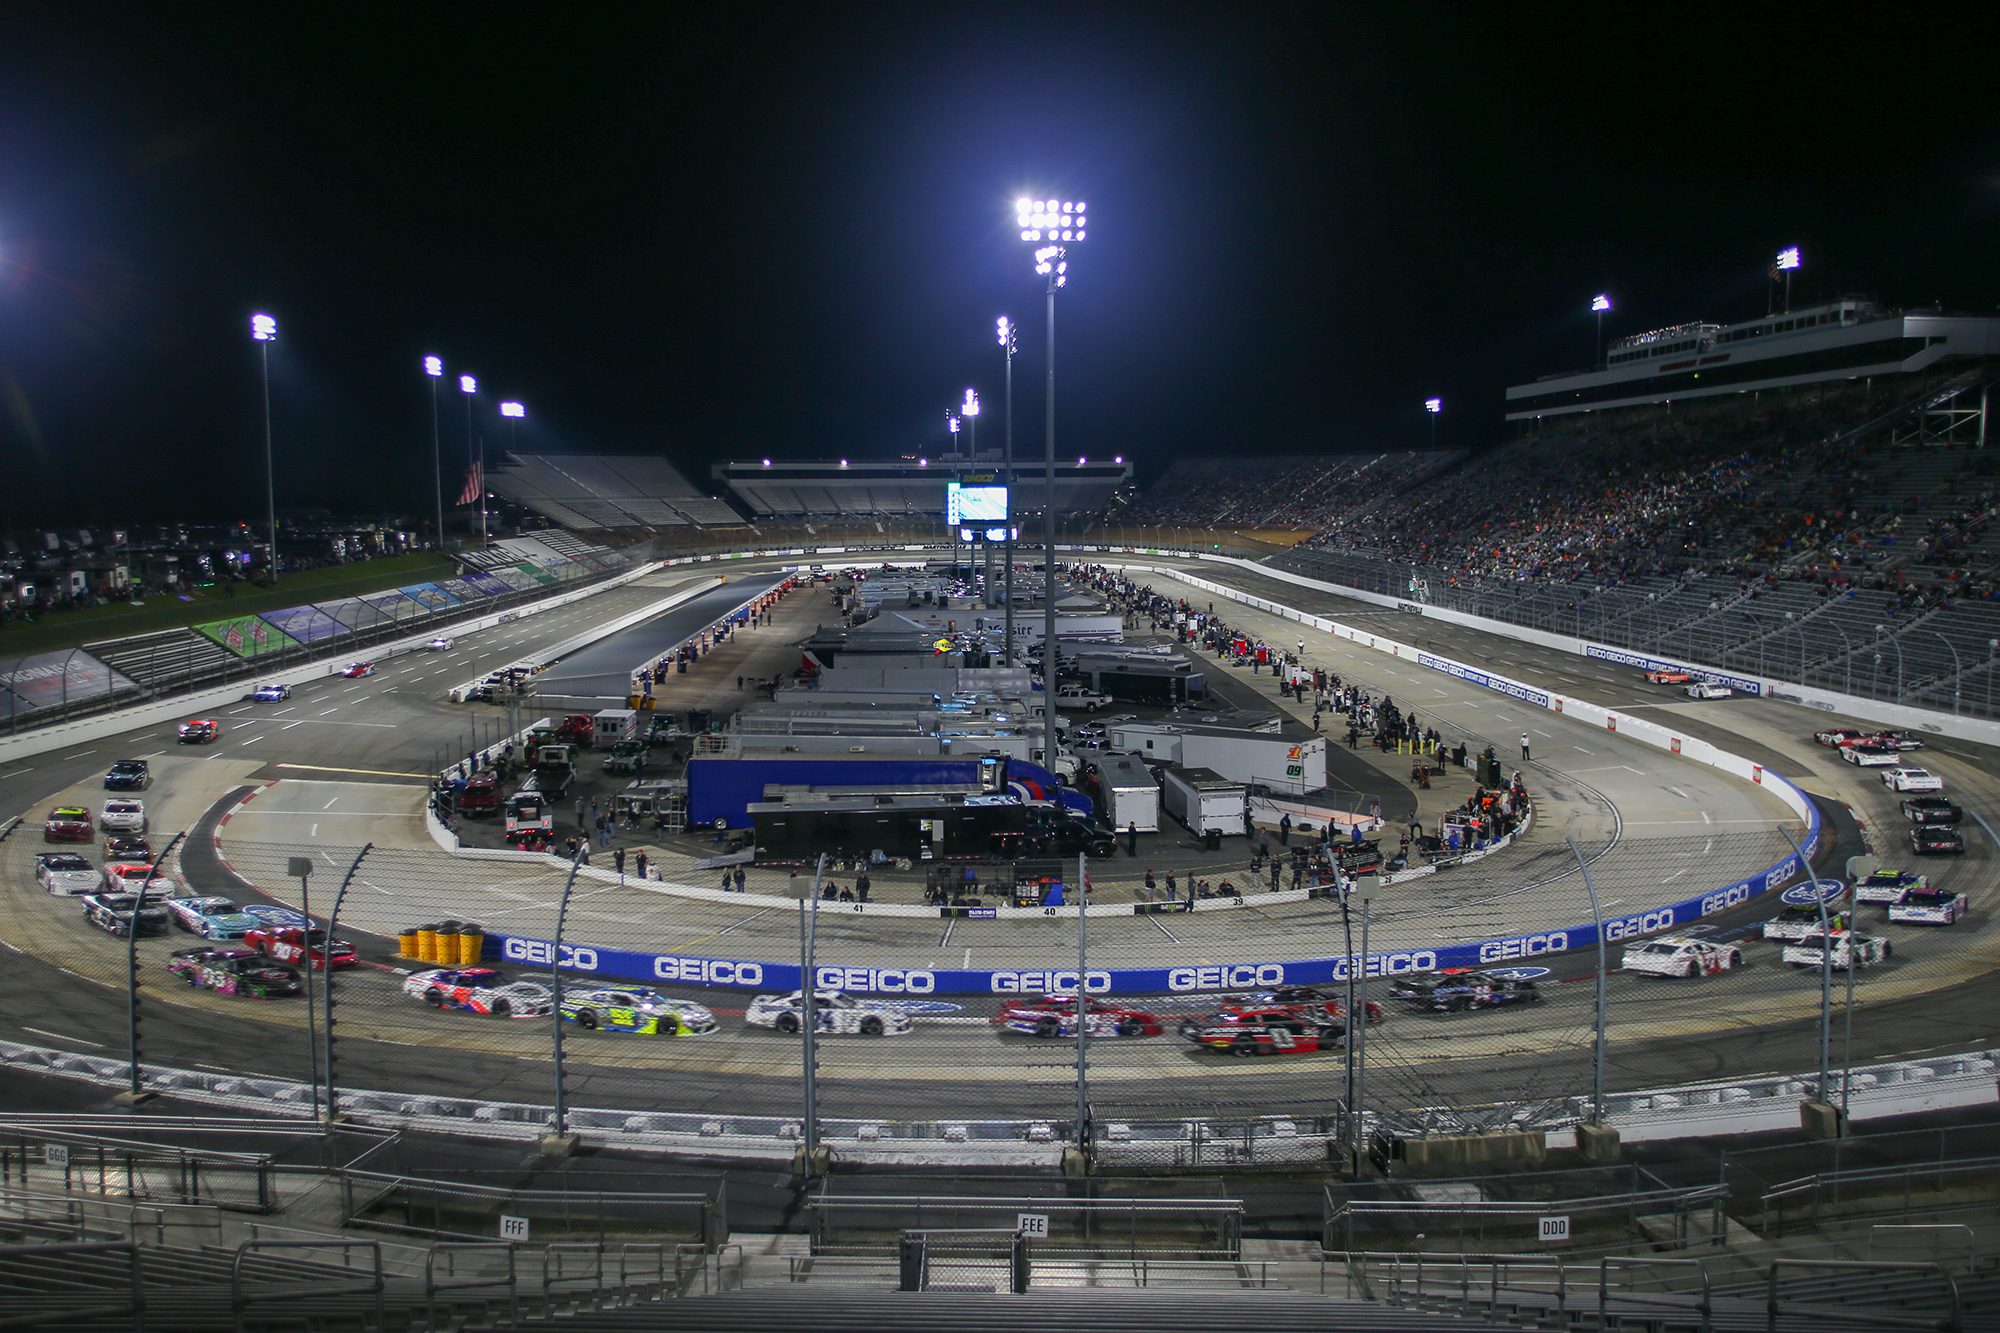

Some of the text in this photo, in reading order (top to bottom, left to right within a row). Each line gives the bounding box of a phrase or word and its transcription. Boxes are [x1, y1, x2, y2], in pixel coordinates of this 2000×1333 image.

[1419, 655, 1433, 667] GEICO
[1433, 660, 1449, 672] GEICO
[1449, 664, 1465, 677] GEICO
[1488, 678, 1506, 692] GEICO
[1506, 684, 1526, 699] GEICO
[1526, 690, 1547, 706] GEICO
[1588, 647, 1606, 659] GEICO
[1606, 651, 1626, 664] GEICO
[1626, 656, 1647, 669] GEICO
[1705, 673, 1729, 686] GEICO
[1731, 679, 1758, 694] GEICO
[1286, 765, 1301, 776] 09
[1765, 859, 1796, 891] GEICO
[854, 904, 864, 913] 41
[1044, 907, 1056, 916] 40
[1233, 897, 1243, 906] 39
[1701, 884, 1749, 917] GEICO
[1606, 909, 1674, 942] GEICO
[505, 937, 598, 970] GEICO
[1479, 932, 1568, 964] GEICO
[654, 956, 763, 985] GEICO
[1168, 964, 1284, 991] GEICO
[1333, 951, 1436, 981] GEICO
[817, 967, 935, 993] GEICO
[990, 970, 1112, 994] GEICO
[505, 1220, 524, 1235] FFF
[1022, 1217, 1043, 1232] EEE
[1543, 1220, 1565, 1235] DDD
